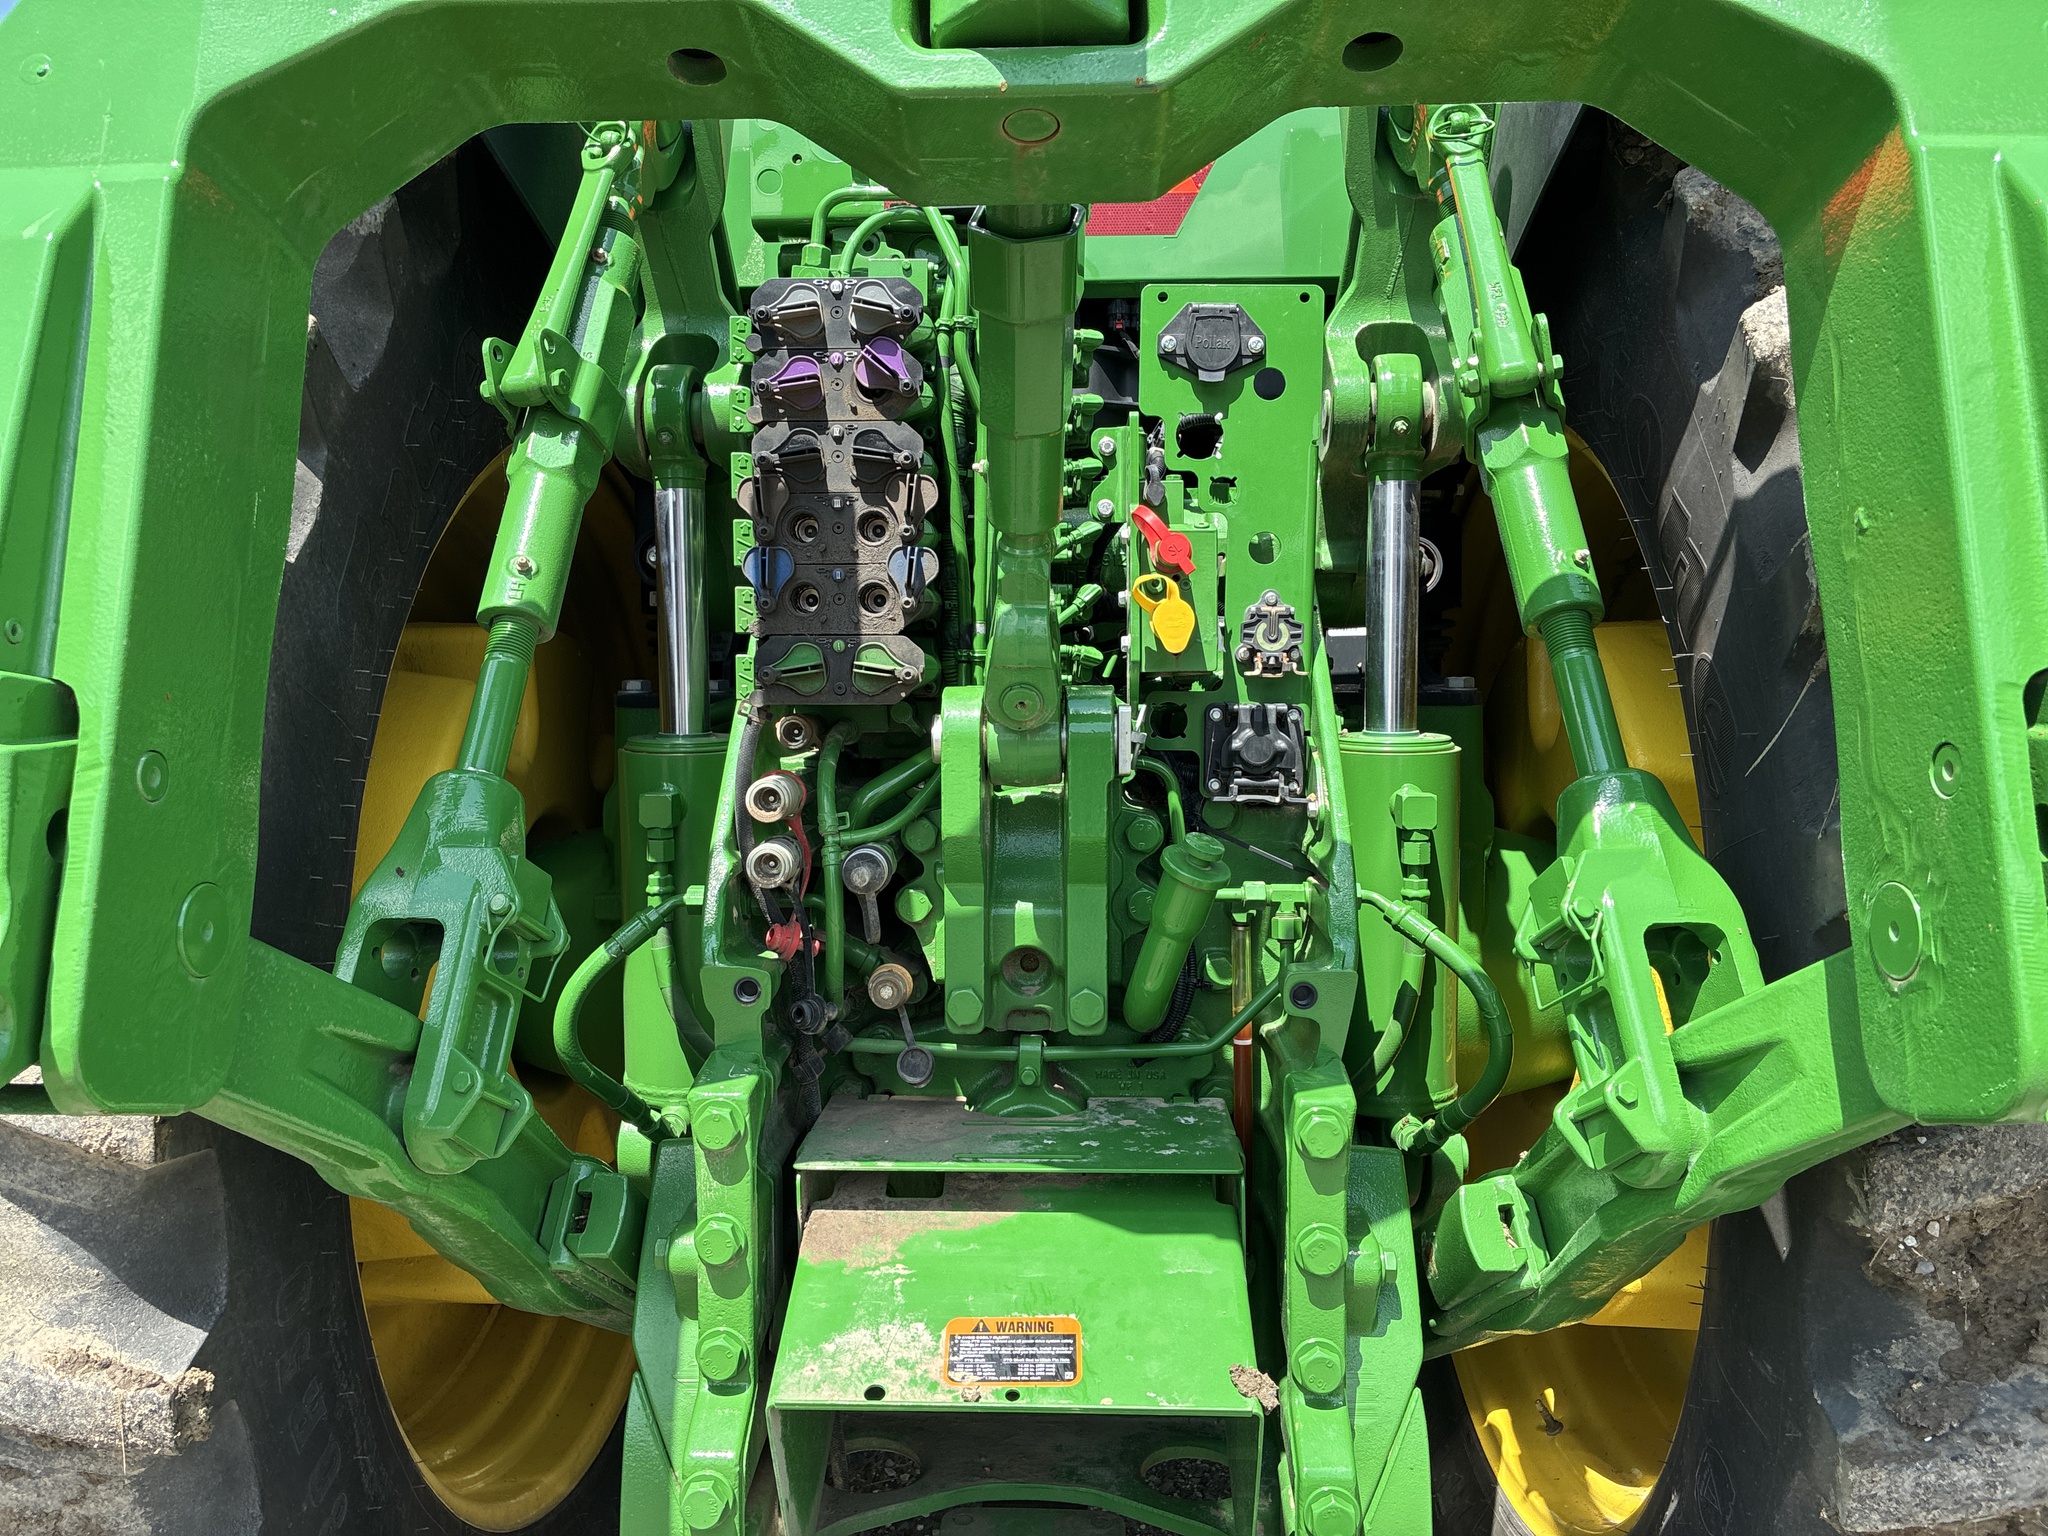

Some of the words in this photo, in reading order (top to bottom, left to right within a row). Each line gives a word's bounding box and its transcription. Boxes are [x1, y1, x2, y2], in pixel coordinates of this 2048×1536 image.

[1193, 334, 1231, 350] Pollak
[1168, 543, 1183, 557] SL
[1127, 1068, 1140, 1079] IN
[1146, 1069, 1167, 1080] USA
[996, 1320, 1054, 1333] WARNING
